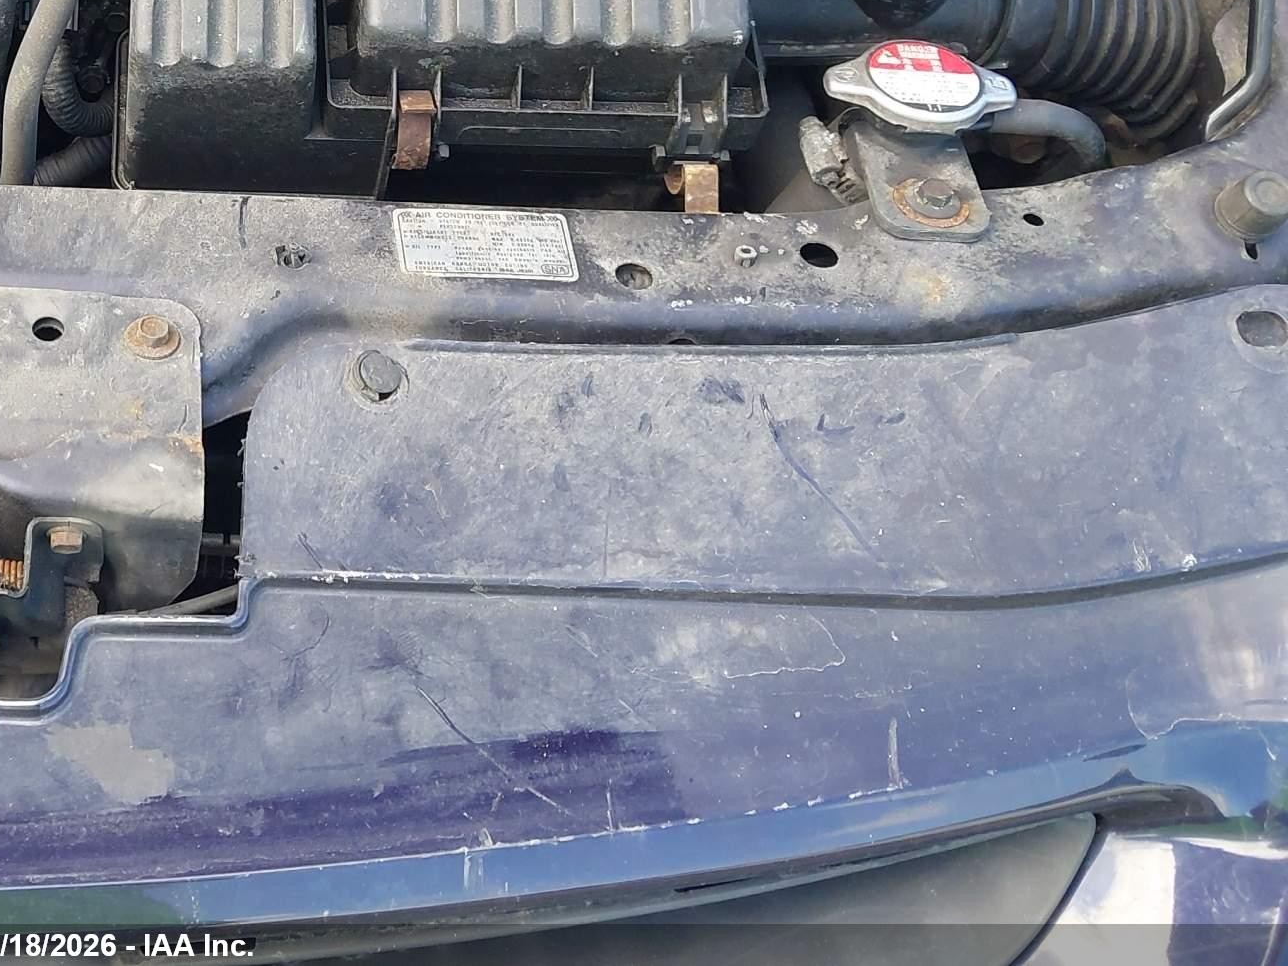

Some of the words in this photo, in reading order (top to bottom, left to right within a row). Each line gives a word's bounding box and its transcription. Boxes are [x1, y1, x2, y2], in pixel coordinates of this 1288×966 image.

[435, 212, 501, 221] CONDITIONER
[506, 213, 546, 222] SYSTEM
[544, 264, 567, 275] SNA
